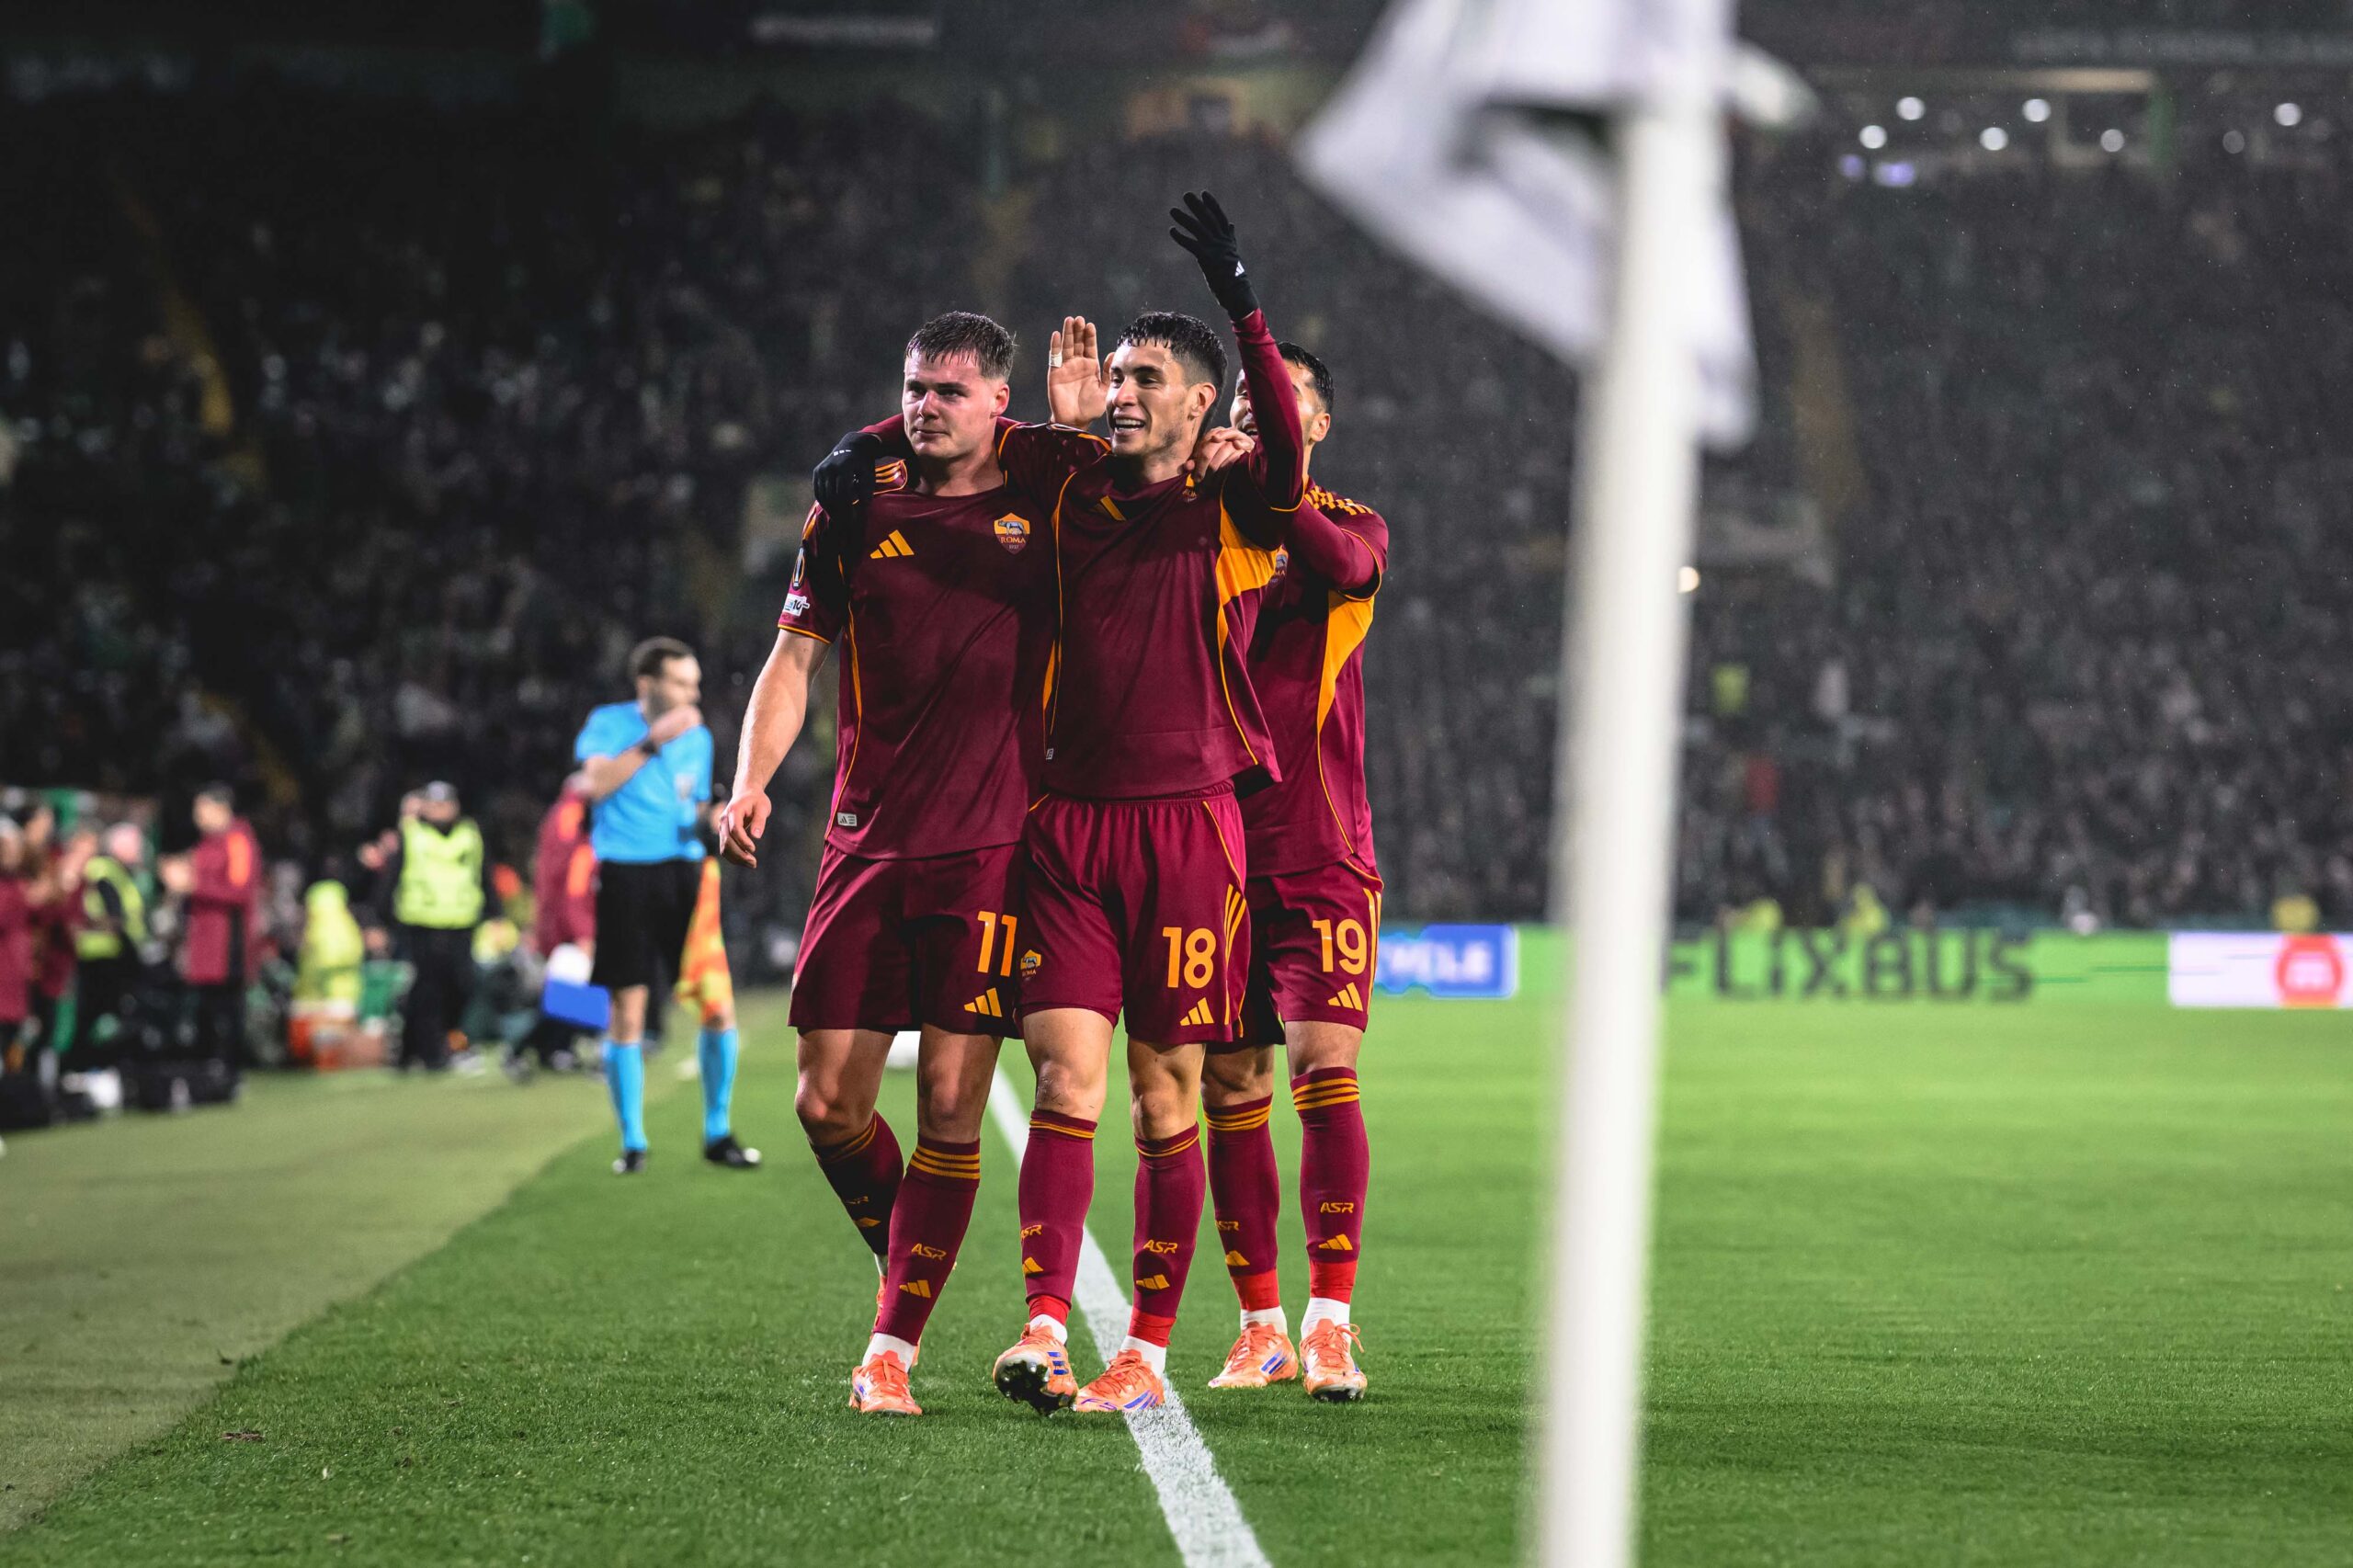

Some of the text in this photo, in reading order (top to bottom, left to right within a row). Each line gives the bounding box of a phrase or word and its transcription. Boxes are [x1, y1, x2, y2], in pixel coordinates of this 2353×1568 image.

[1000, 536, 1027, 544] ROMA
[977, 910, 1017, 978] 11
[1313, 919, 1368, 975] 19
[1163, 926, 1217, 989] 18
[1321, 1202, 1355, 1213] ASR
[911, 1243, 947, 1260] ASR
[1142, 1240, 1178, 1254] ASR
